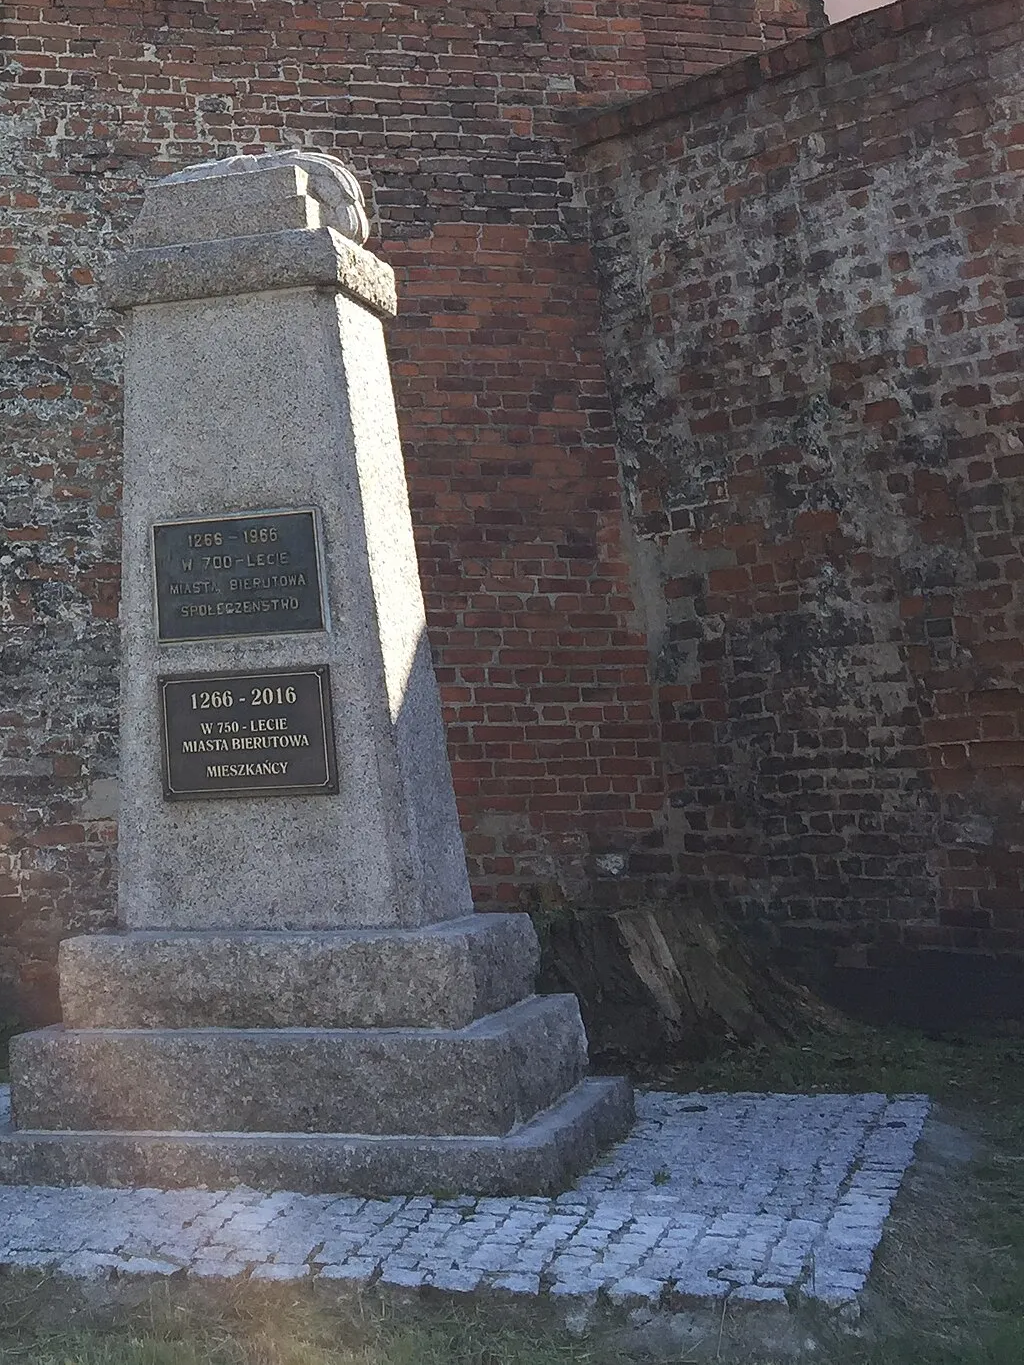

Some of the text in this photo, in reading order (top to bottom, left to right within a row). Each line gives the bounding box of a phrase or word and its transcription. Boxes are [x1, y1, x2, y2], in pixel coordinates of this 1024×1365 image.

[188, 532, 223, 547] 1266
[243, 527, 278, 544] 1966
[182, 558, 193, 571] W
[169, 574, 306, 595] MIASTA BIERUTOWA
[191, 690, 233, 709] 1266
[251, 687, 297, 706] 2016
[200, 723, 213, 734] W
[218, 721, 239, 733] 750
[251, 718, 287, 732] LECIE
[182, 734, 309, 753] MIASTA BIERUTOWA
[207, 760, 288, 777] MIESZKAŃCY
